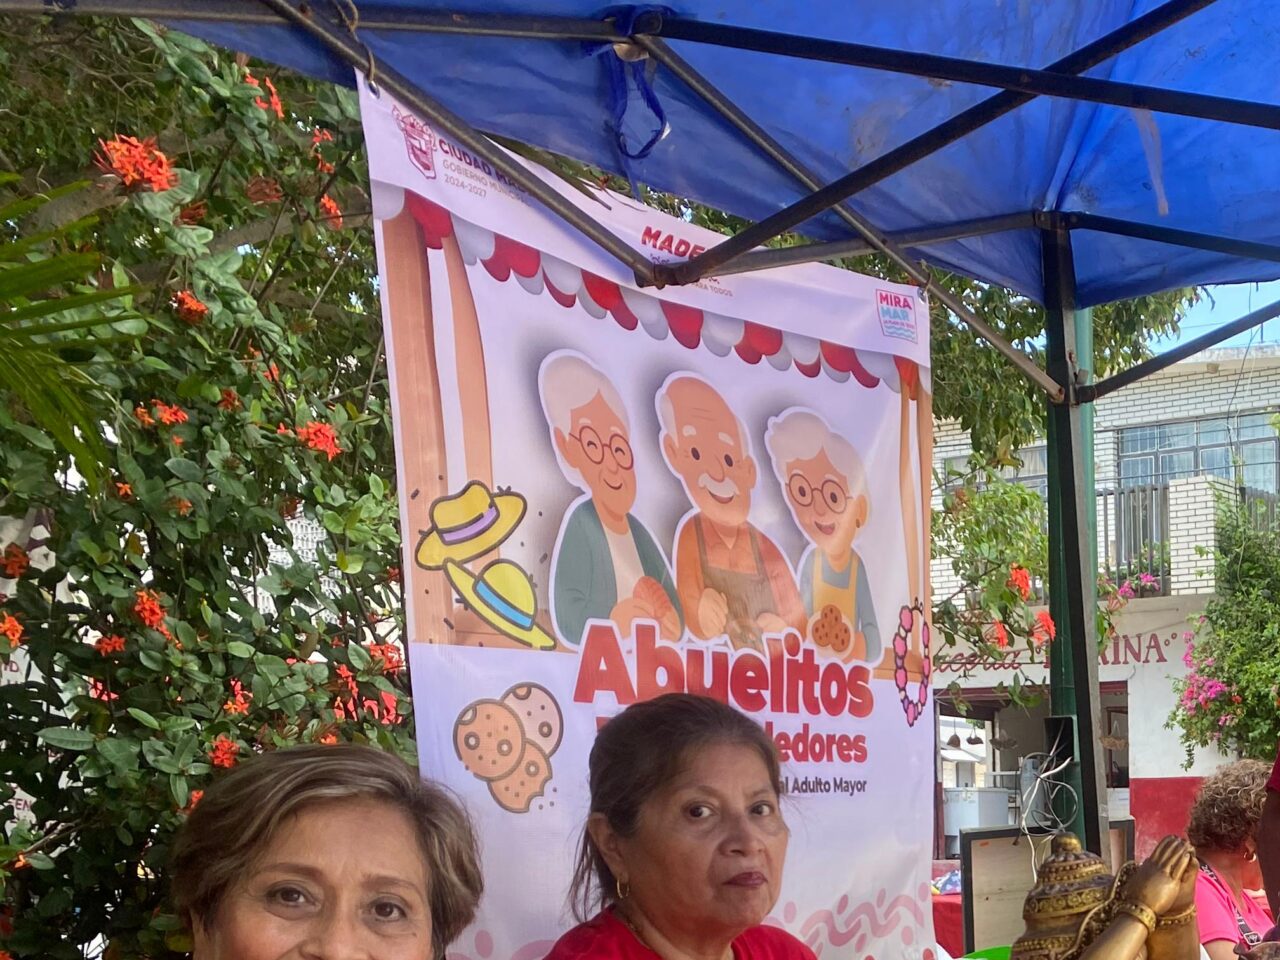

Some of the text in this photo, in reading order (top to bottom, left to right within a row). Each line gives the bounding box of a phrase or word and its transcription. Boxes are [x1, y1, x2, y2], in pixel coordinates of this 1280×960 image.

[438, 137, 492, 177] CIUDAD
[442, 159, 488, 186] GOBIERNO
[879, 292, 912, 310] MIRA
[573, 623, 875, 718] Abuelitos
[791, 776, 831, 794] Adulto
[833, 777, 867, 797] Mayor
